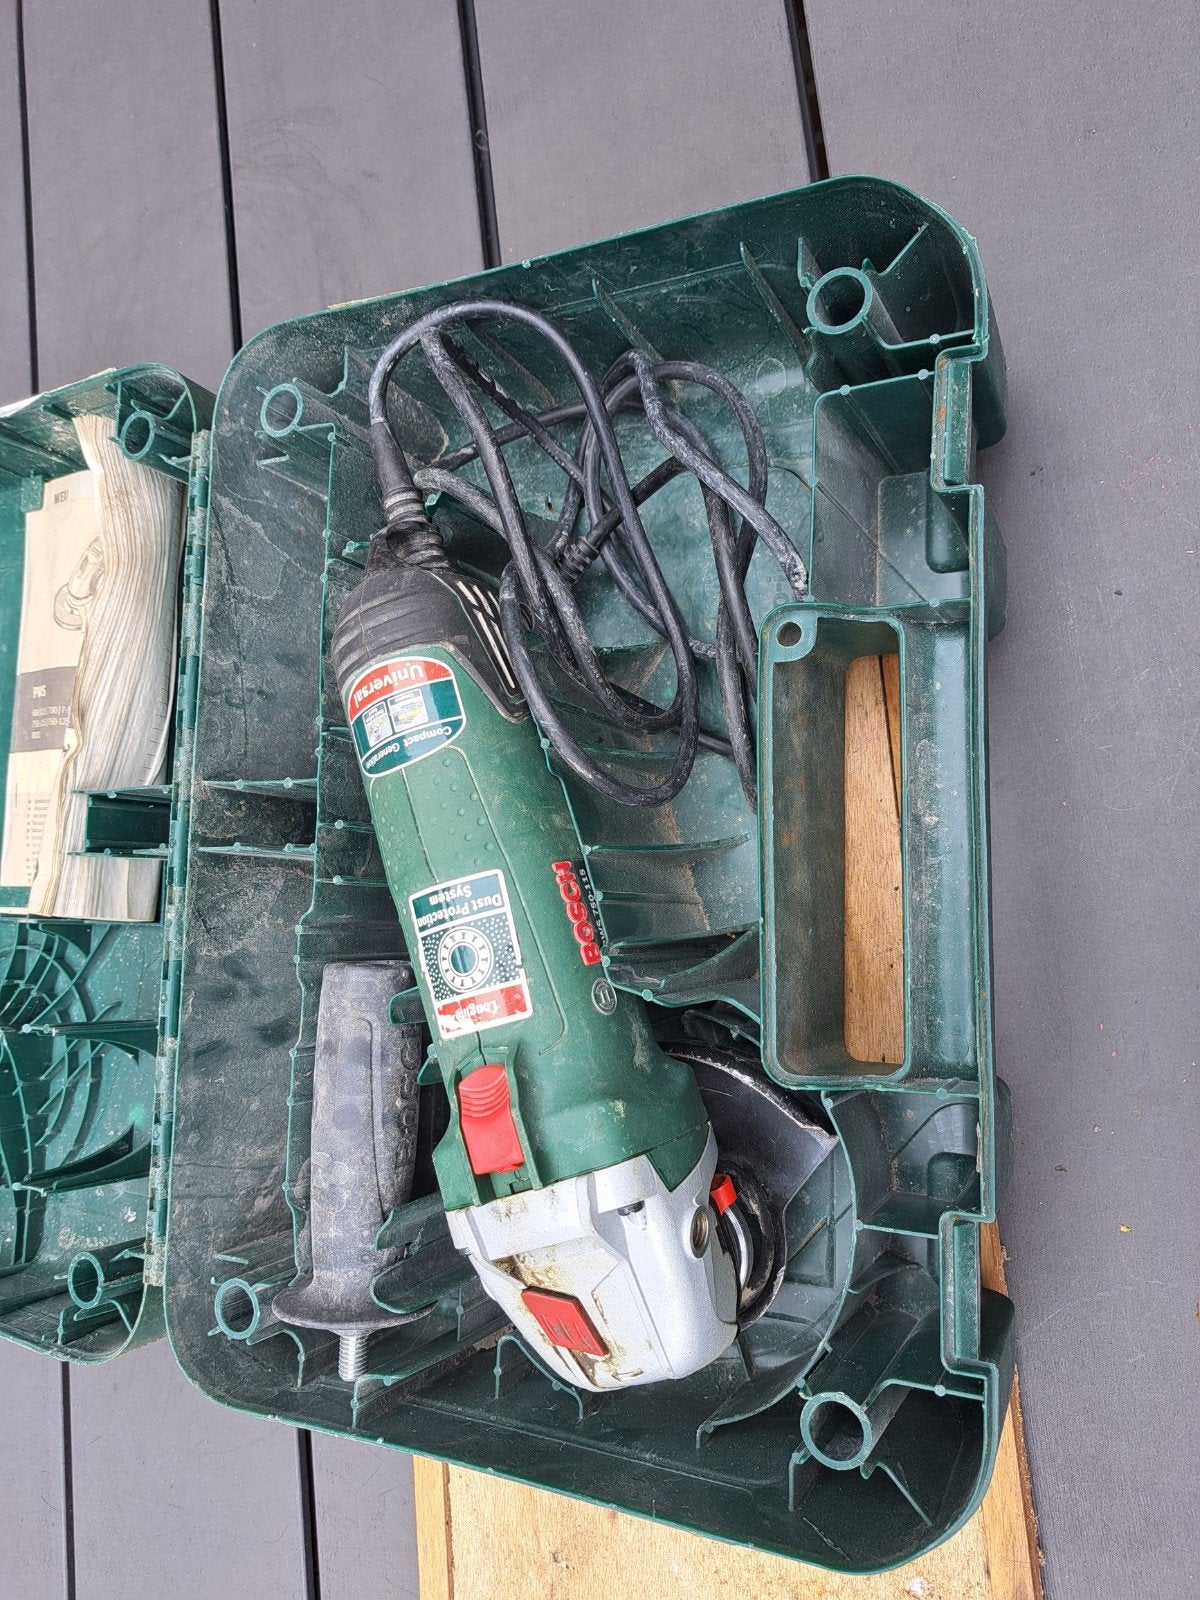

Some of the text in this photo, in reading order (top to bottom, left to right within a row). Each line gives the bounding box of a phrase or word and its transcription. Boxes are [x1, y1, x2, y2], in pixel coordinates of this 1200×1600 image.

[352, 662, 425, 709] Universal
[404, 726, 453, 747] Compact
[366, 743, 401, 769] Generation
[417, 893, 503, 928] Dust Protection
[429, 885, 472, 906] System
[552, 861, 602, 966] BOSCH
